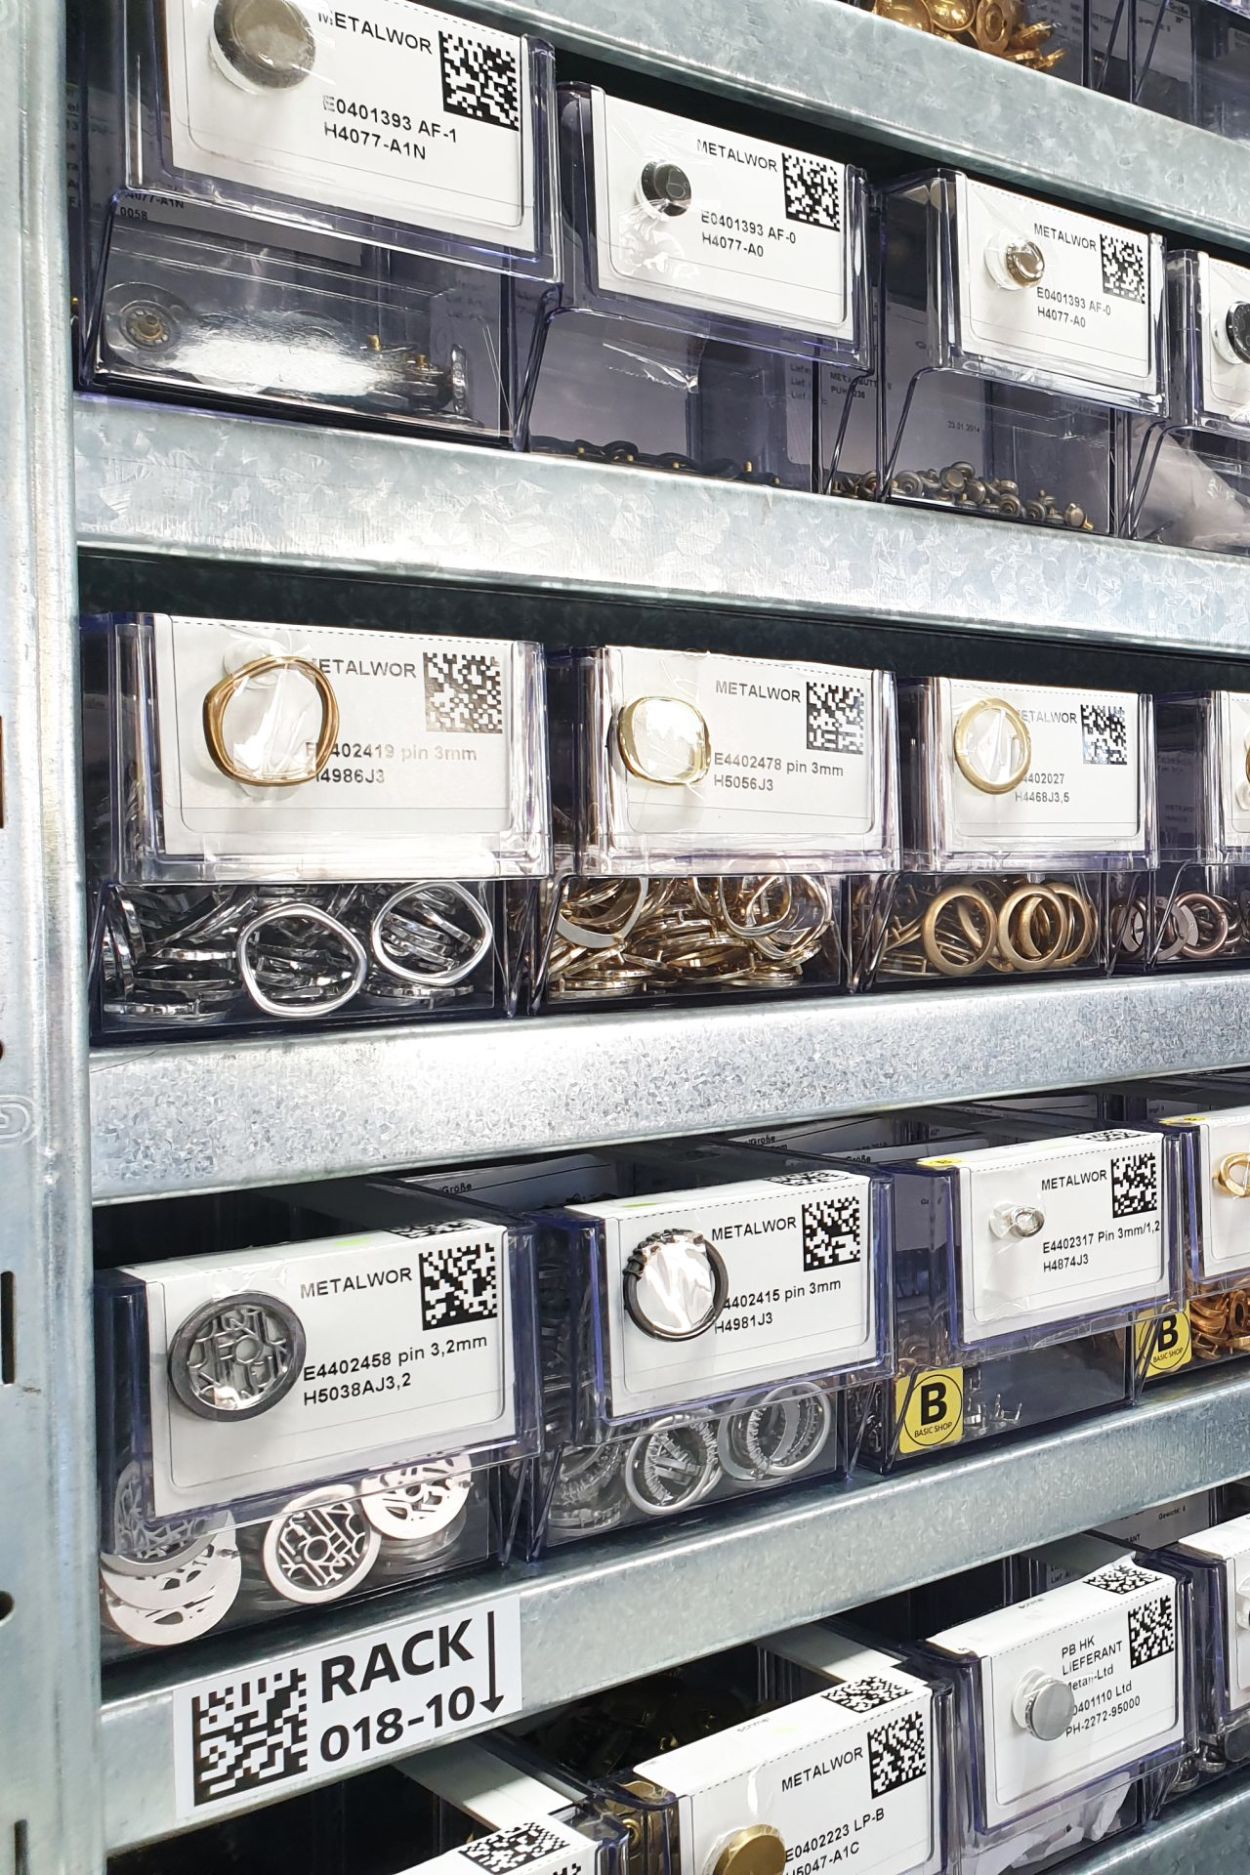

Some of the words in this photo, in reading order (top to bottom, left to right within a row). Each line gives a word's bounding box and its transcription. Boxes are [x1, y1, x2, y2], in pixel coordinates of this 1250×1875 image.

[322, 95, 412, 131] E0401393
[418, 120, 457, 143] AF-1
[324, 121, 426, 160] H4077-A1N
[697, 139, 778, 172] METALWOR
[701, 211, 764, 236] E0401393
[768, 226, 796, 244] AF-0
[1034, 223, 1097, 251] METALWOR
[702, 232, 764, 257] H4077-A0
[1037, 286, 1086, 309] E0401393
[1089, 299, 1111, 316] AF-0
[1037, 306, 1086, 328] H4077-A0
[314, 657, 416, 678] ETALWOR
[715, 680, 801, 703] METALWOR
[1019, 709, 1077, 724] ETALWOR
[401, 746, 428, 762] pin
[436, 746, 477, 761] 3mm
[714, 752, 781, 770] E4402478
[786, 760, 807, 774] pin
[811, 762, 844, 776] 3mm
[714, 774, 774, 791] H5056J3
[1023, 773, 1065, 784] 402027
[1042, 1170, 1108, 1191] METALWOR
[711, 1217, 797, 1241] METALWOR
[1043, 1234, 1094, 1253] E4402317
[1098, 1230, 1114, 1243] Pin
[1118, 1220, 1160, 1239] 3mm/1,2
[1044, 1254, 1089, 1272] H4874J3
[300, 1267, 413, 1299] METALWOR
[722, 1289, 780, 1310] 4402415
[784, 1285, 805, 1302] pin
[809, 1280, 841, 1295] 3mm
[714, 1312, 773, 1334] H4981J3
[1157, 1313, 1178, 1352] B
[304, 1352, 391, 1381] E4402458
[398, 1347, 425, 1367] pin
[431, 1336, 488, 1357] 3,2mm
[304, 1373, 411, 1406] H5038AJ3,2
[921, 1382, 947, 1426] B
[914, 1426, 933, 1438] BASIC
[934, 1421, 953, 1433] SHOP
[321, 1618, 475, 1703] RACK
[1061, 1643, 1076, 1659] PB
[1079, 1635, 1095, 1652] HK
[1062, 1640, 1123, 1675] LIEFERANT
[1073, 1689, 1112, 1716] 0401110
[1115, 1680, 1132, 1697] Ltd
[320, 1686, 475, 1763] 018-10
[1065, 1695, 1140, 1737] PH-2272-95000
[781, 1747, 864, 1792] METALWOR
[785, 1823, 850, 1862] E0402223
[854, 1807, 885, 1831] LP-B
[786, 1841, 860, 1875] 5047-A1C
